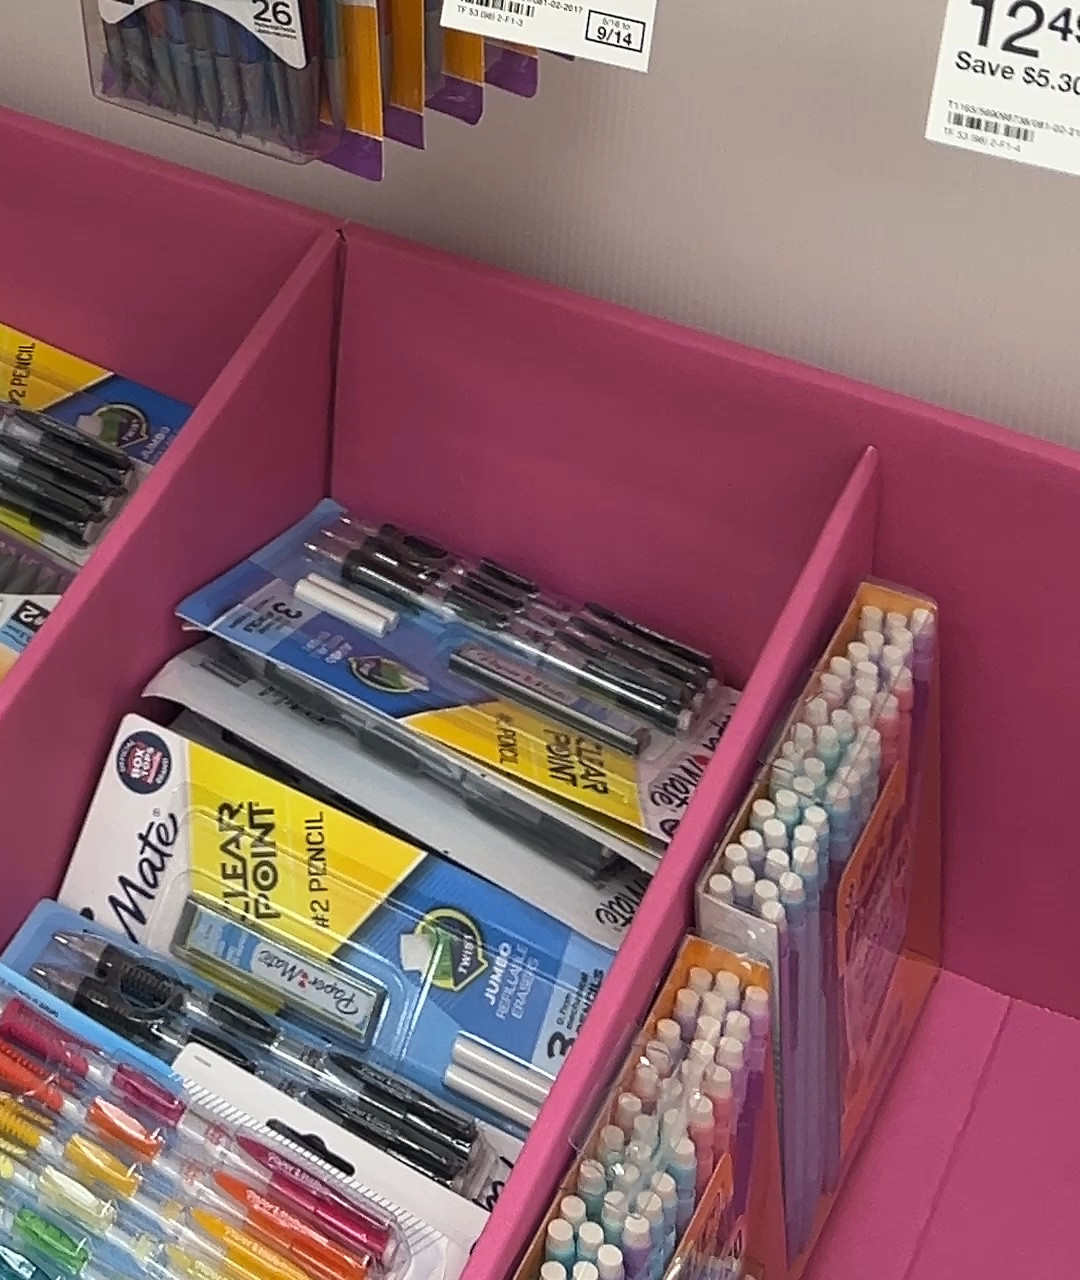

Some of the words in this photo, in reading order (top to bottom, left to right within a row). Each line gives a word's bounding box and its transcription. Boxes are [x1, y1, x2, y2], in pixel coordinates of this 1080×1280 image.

[597, 26, 632, 46] 9/14
[955, 50, 1015, 80] Save
[12, 342, 36, 386] PENCIL
[249, 801, 280, 920] POINT
[305, 810, 327, 892] PENCIL
[309, 977, 358, 1015] Paper
